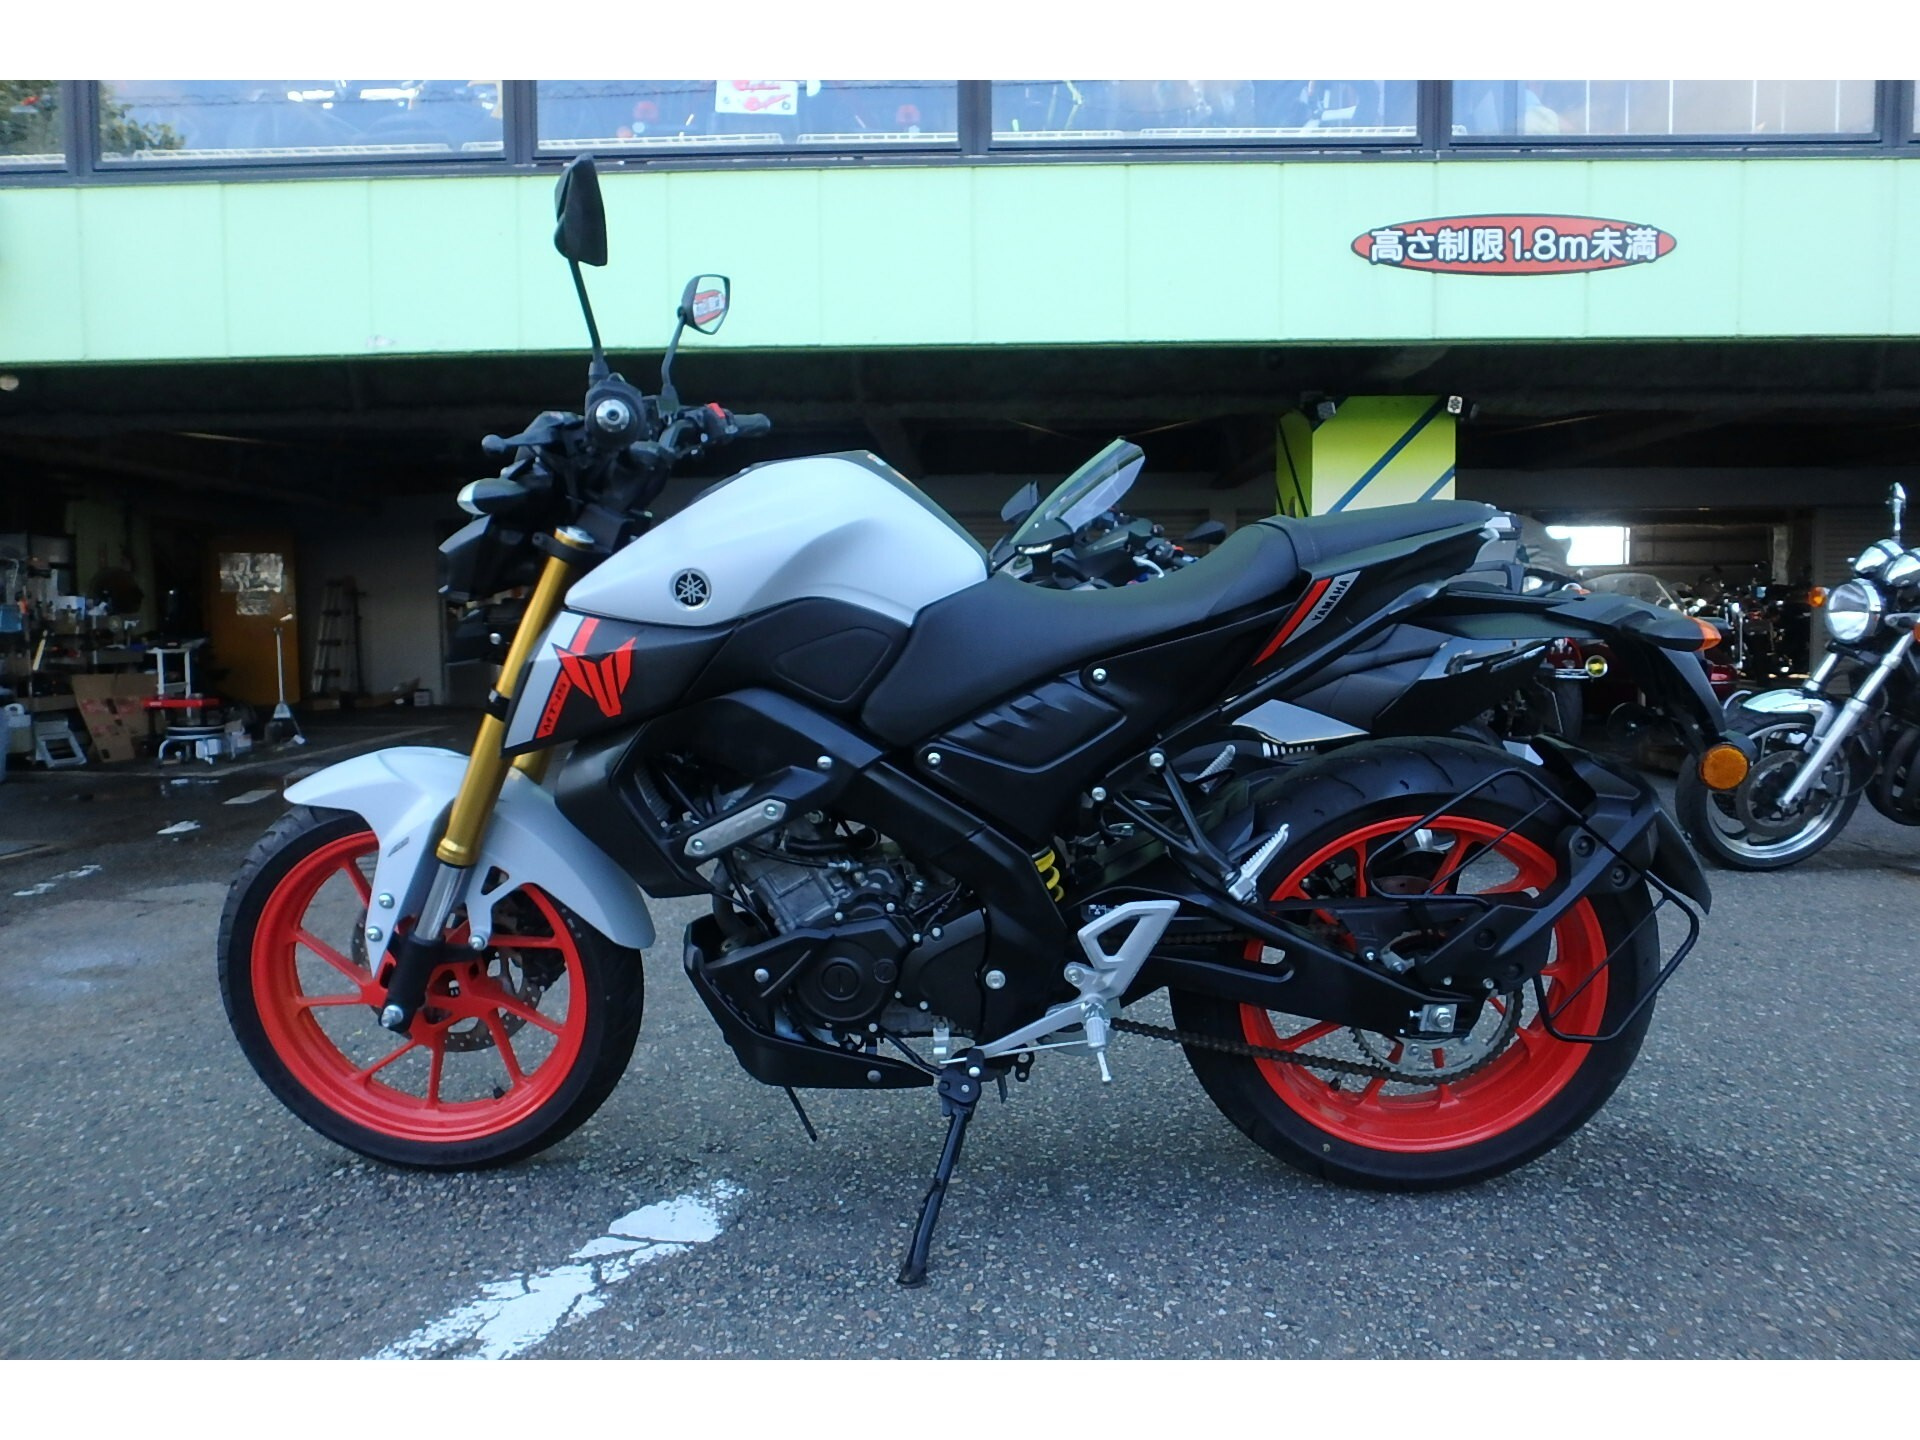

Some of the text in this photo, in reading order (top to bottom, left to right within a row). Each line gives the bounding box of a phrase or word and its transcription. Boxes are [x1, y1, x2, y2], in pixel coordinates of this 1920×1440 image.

[1370, 227, 1659, 263] 高さ制限1.8m未満
[1312, 580, 1350, 622] YAMAHA
